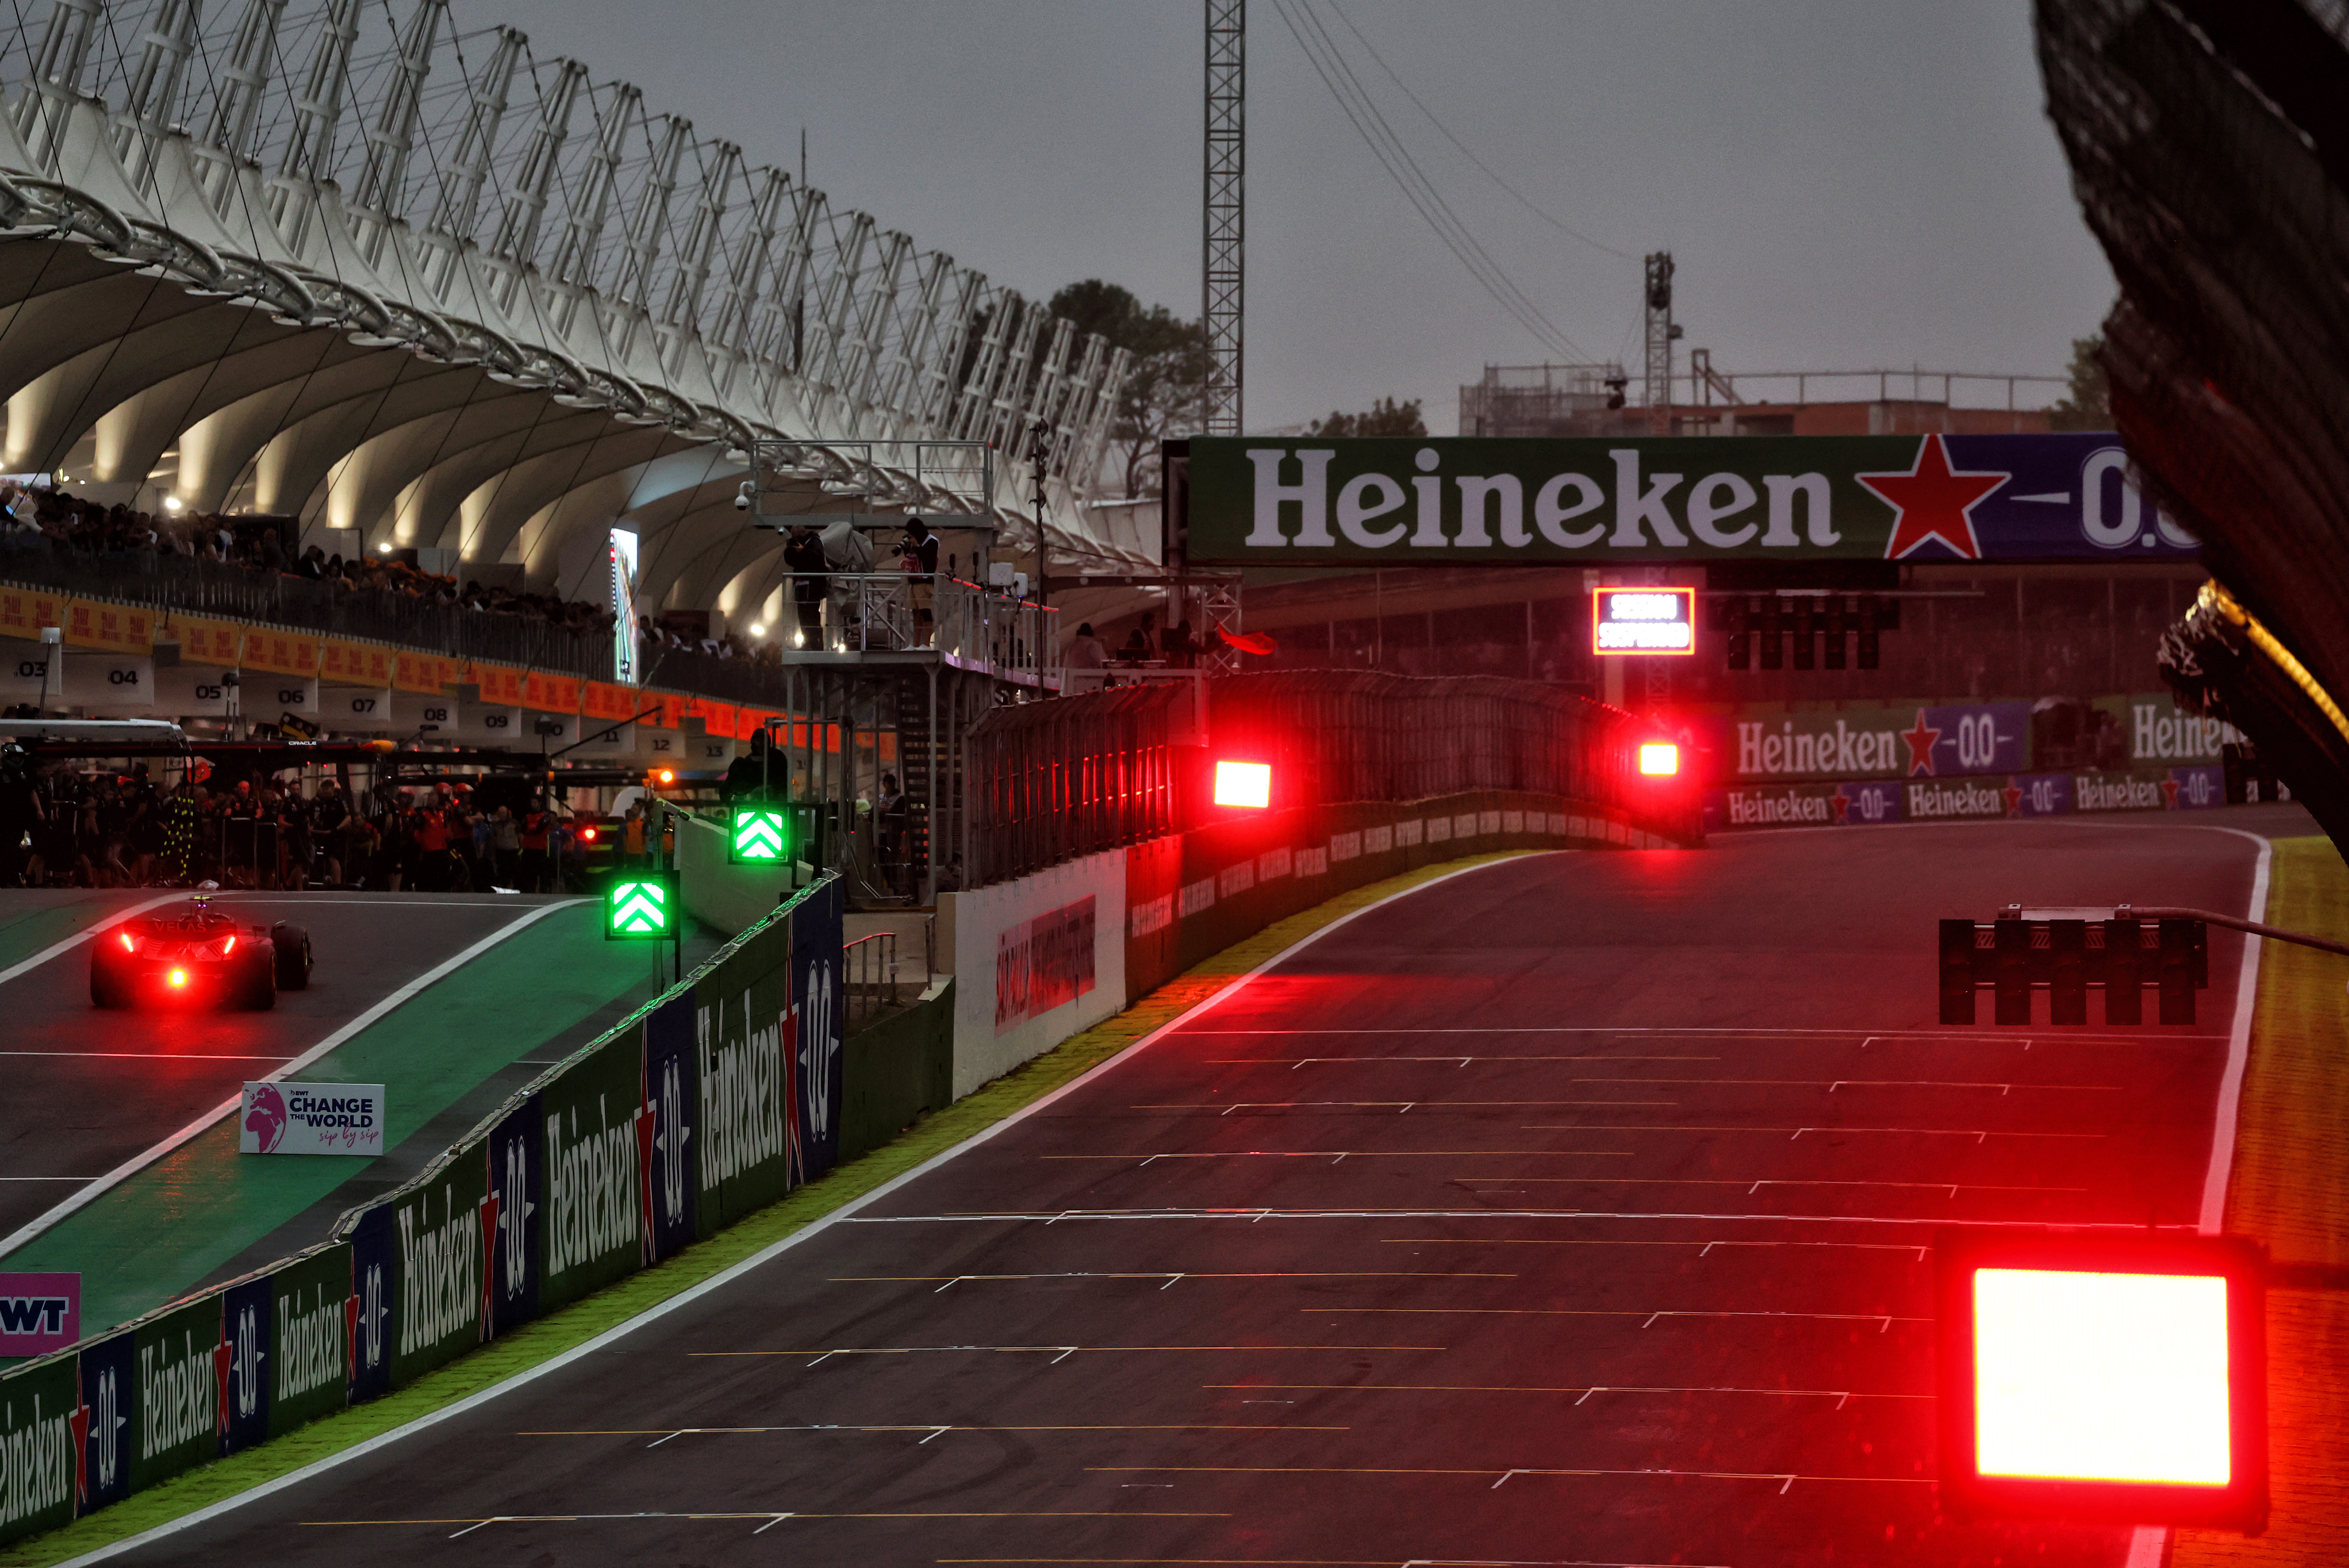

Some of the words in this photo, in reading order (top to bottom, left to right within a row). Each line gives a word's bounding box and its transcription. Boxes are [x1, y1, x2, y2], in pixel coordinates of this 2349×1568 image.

[1244, 446, 1841, 549] Heineken
[19, 661, 47, 677] 03
[110, 670, 138, 685] 04
[196, 685, 221, 699] 05
[279, 690, 304, 704] 06
[352, 699, 375, 713] 07
[424, 709, 447, 721] 08
[485, 715, 508, 729] 09
[653, 739, 670, 751] 12
[1737, 719, 1898, 775] Heineken
[1958, 713, 1994, 768] 0.0
[2132, 704, 2223, 759] Heine
[707, 745, 724, 757] 13
[1727, 790, 1829, 824] Heineken
[1908, 782, 2002, 817] Heineken
[2075, 774, 2161, 810] Heineken
[155, 922, 207, 933] VELAS
[290, 1097, 373, 1113] CHANGE
[698, 988, 782, 1192] Heineken
[306, 1114, 373, 1128] WORLD
[319, 1129, 338, 1146] sip
[342, 1122, 356, 1148] by
[360, 1128, 379, 1144] sip
[547, 1093, 636, 1277] Heineken
[399, 1183, 476, 1356] Heineken
[0, 1297, 69, 1335] WT
[279, 1283, 342, 1401] Heineken
[142, 1330, 214, 1460] Heineken
[0, 1393, 68, 1527] eineken
